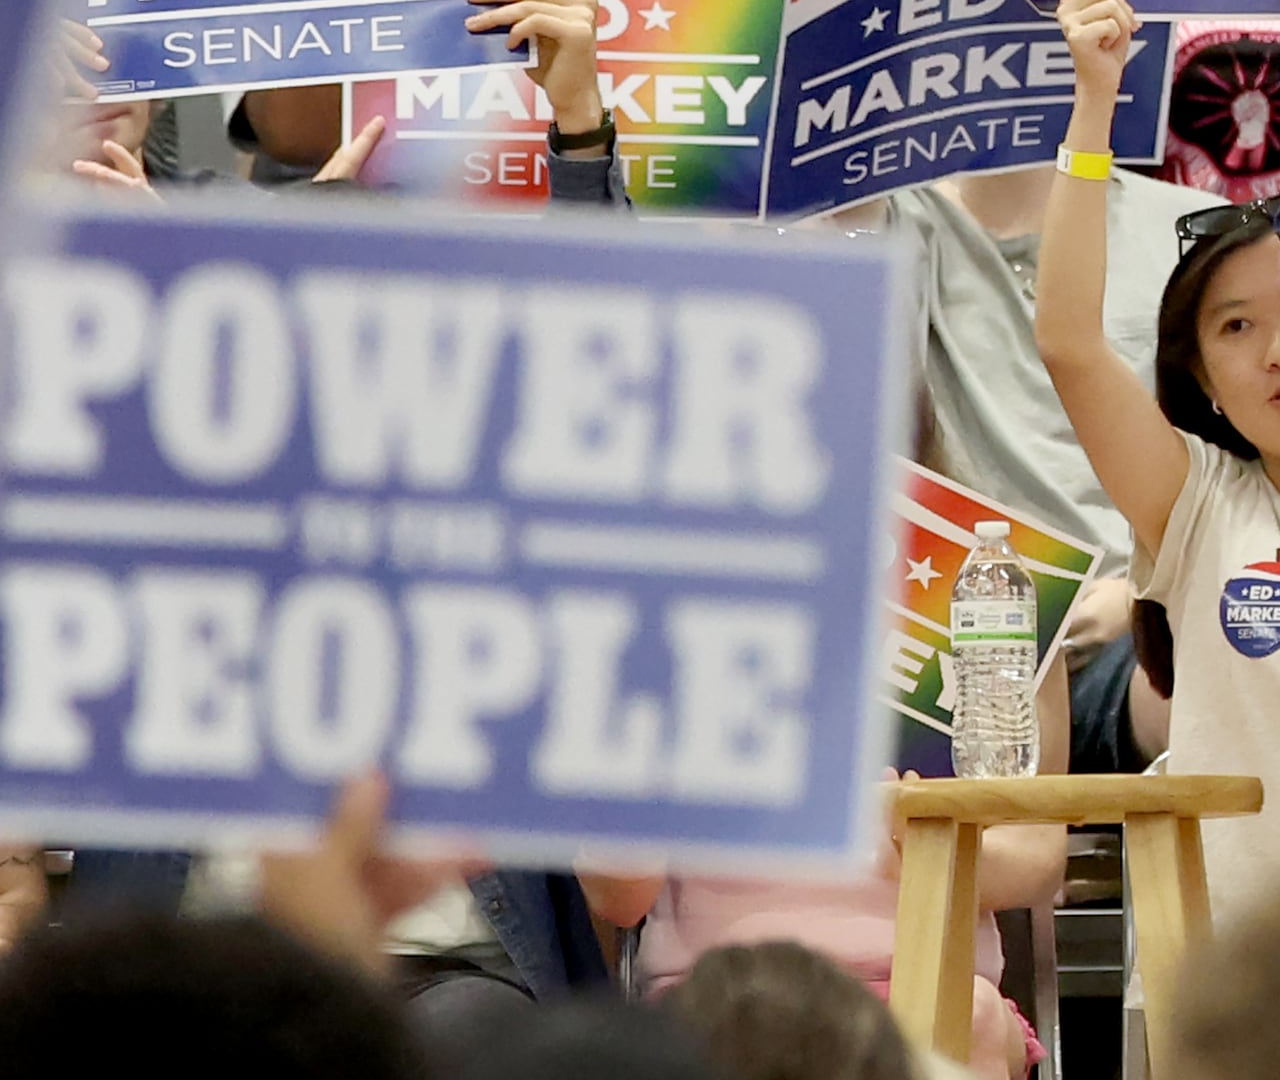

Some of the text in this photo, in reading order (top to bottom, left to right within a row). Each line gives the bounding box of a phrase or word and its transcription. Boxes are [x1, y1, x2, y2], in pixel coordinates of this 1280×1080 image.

[162, 15, 406, 69] SENATE
[395, 70, 768, 125] MAKEY
[794, 38, 1148, 149] MARKEY
[463, 151, 677, 188] SENTE
[842, 114, 1046, 186] SENATE
[2, 253, 831, 513] POWER
[1250, 585, 1274, 601] ED
[0, 563, 816, 810] PEOPLE
